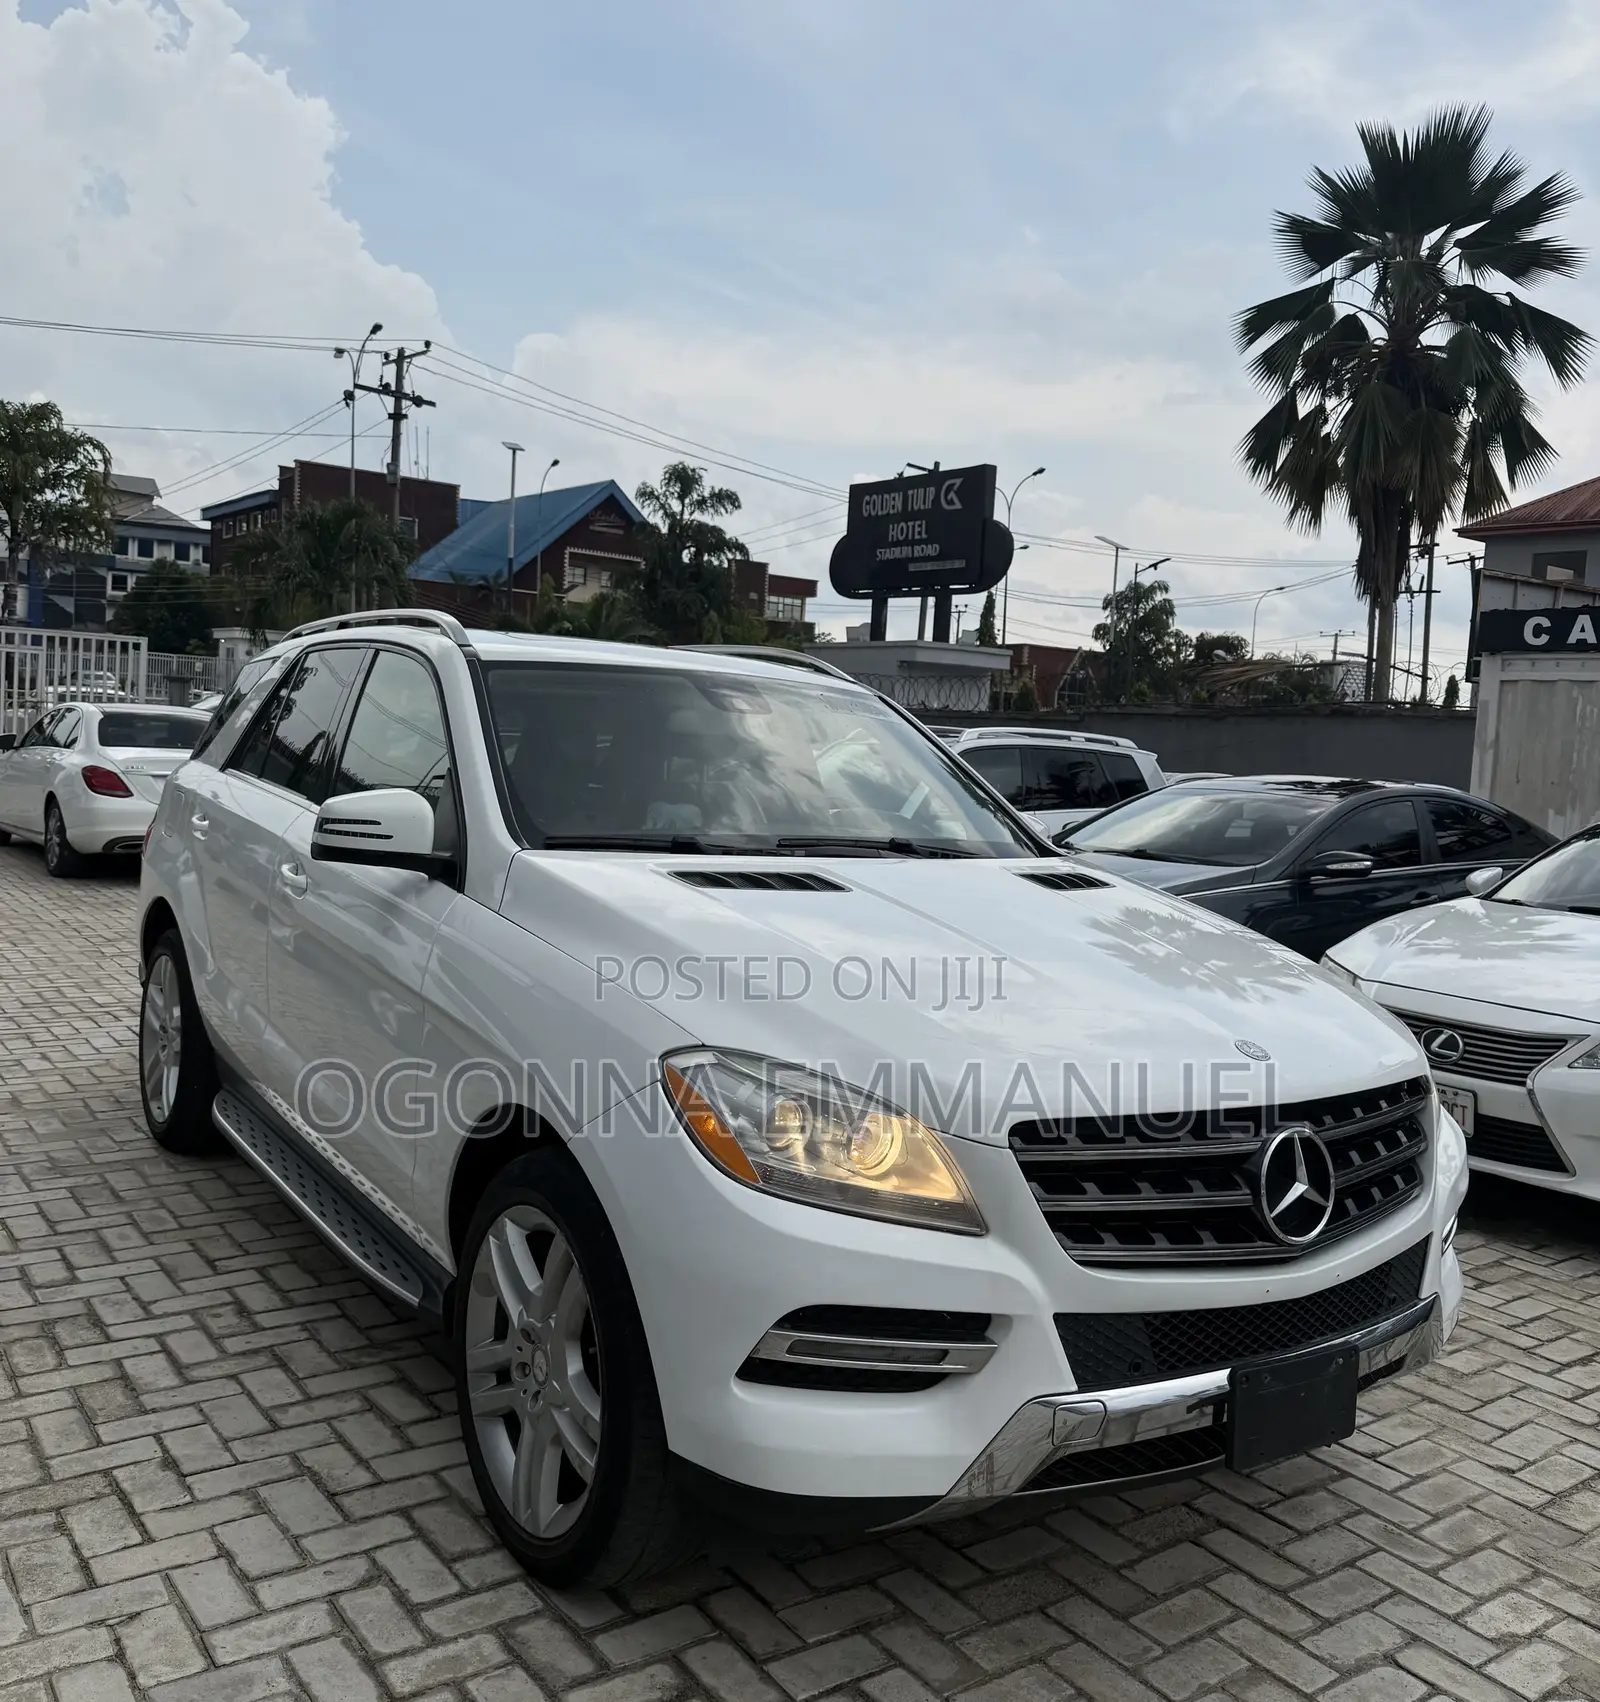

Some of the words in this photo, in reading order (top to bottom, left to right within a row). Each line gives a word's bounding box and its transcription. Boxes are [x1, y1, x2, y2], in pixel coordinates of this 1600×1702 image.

[862, 491, 903, 518] GOLDEN
[907, 486, 936, 512] TULIP
[888, 519, 928, 543] HOTEL
[876, 545, 912, 561] STADIUM
[913, 543, 940, 558] ROAD
